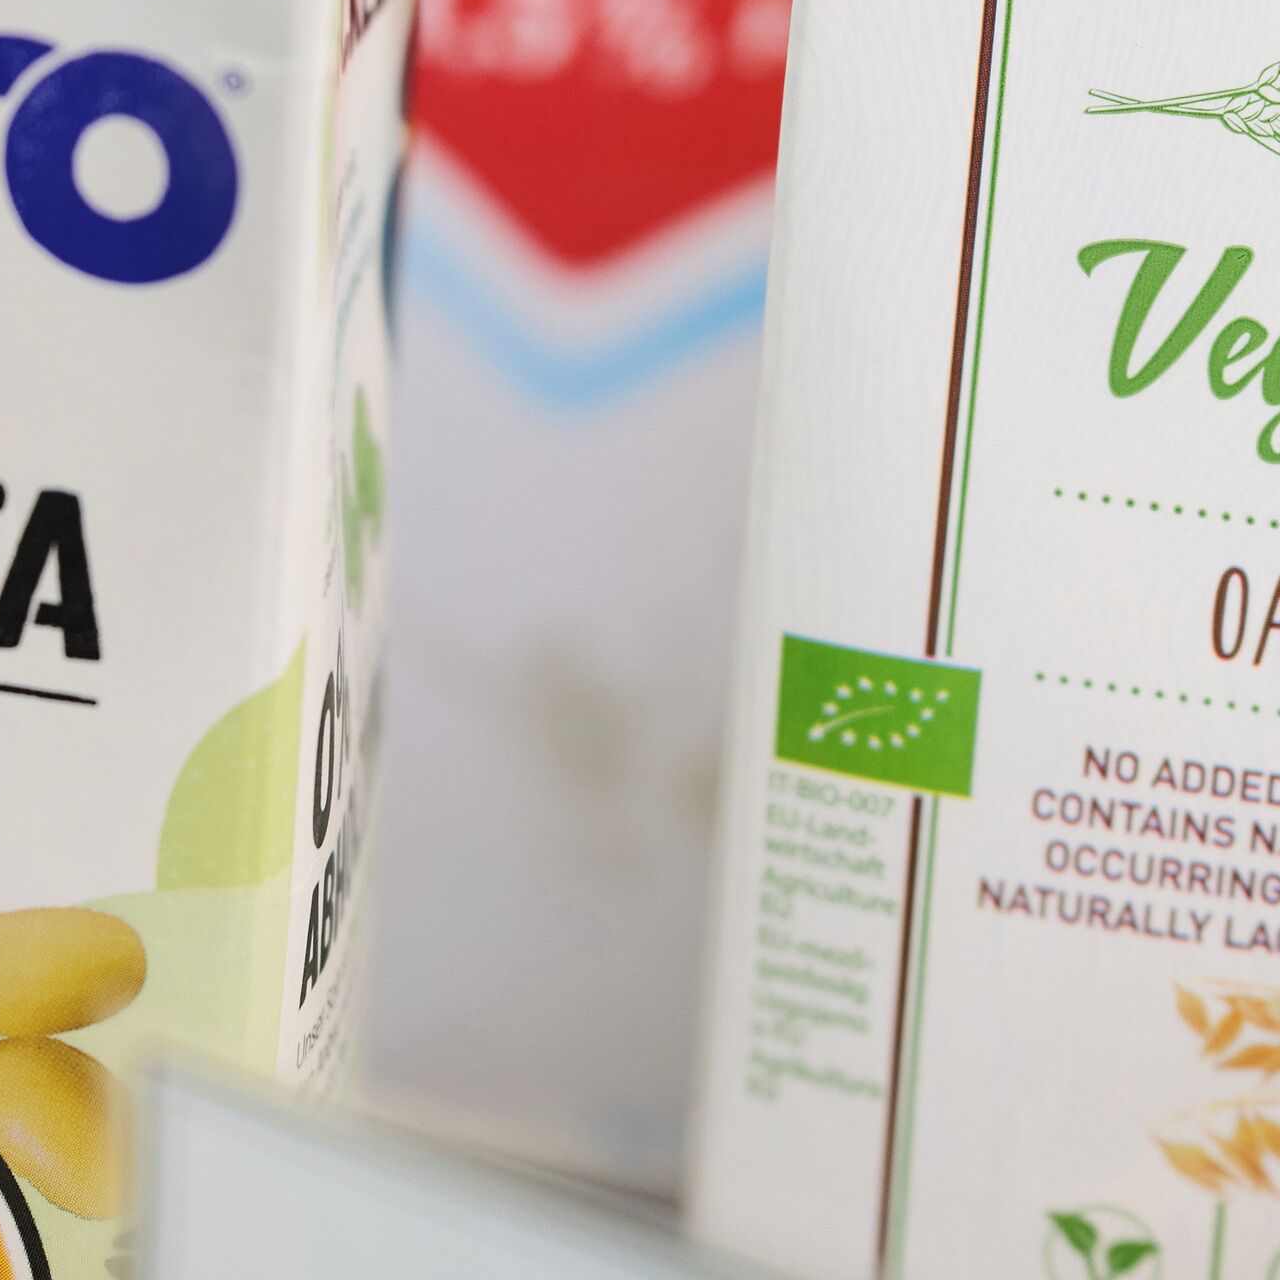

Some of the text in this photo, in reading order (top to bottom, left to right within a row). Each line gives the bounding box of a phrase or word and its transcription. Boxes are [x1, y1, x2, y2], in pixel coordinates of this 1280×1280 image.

[1082, 746, 1140, 784] NO
[1031, 788, 1236, 849] CONTAINS
[978, 877, 1212, 945] NATURALLY
